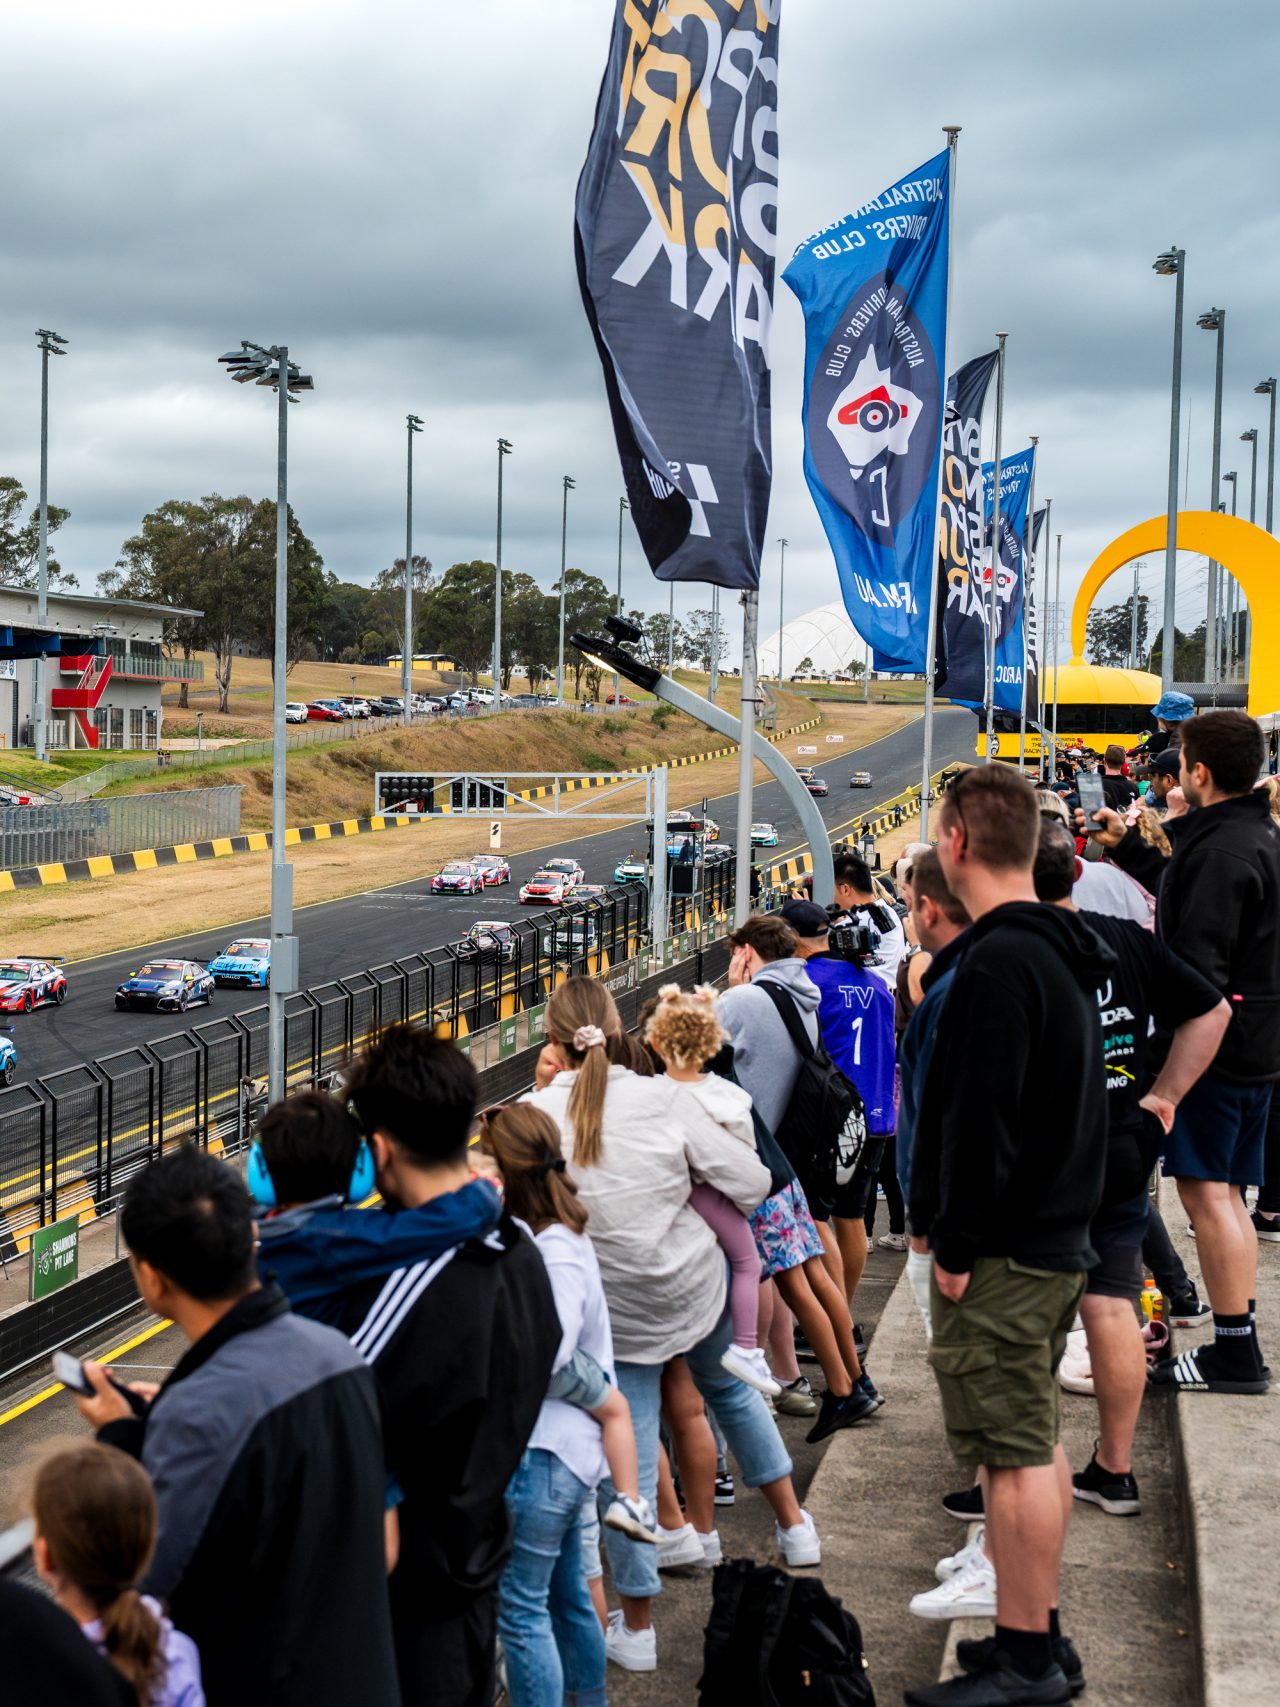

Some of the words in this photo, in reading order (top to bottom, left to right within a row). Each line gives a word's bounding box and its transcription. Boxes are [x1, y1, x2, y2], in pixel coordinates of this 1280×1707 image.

[839, 985, 874, 1009] TV
[852, 1017, 864, 1066] 1
[52, 1232, 77, 1256] SHANNONS
[54, 1255, 64, 1271] PIT
[64, 1249, 74, 1266] LANE
